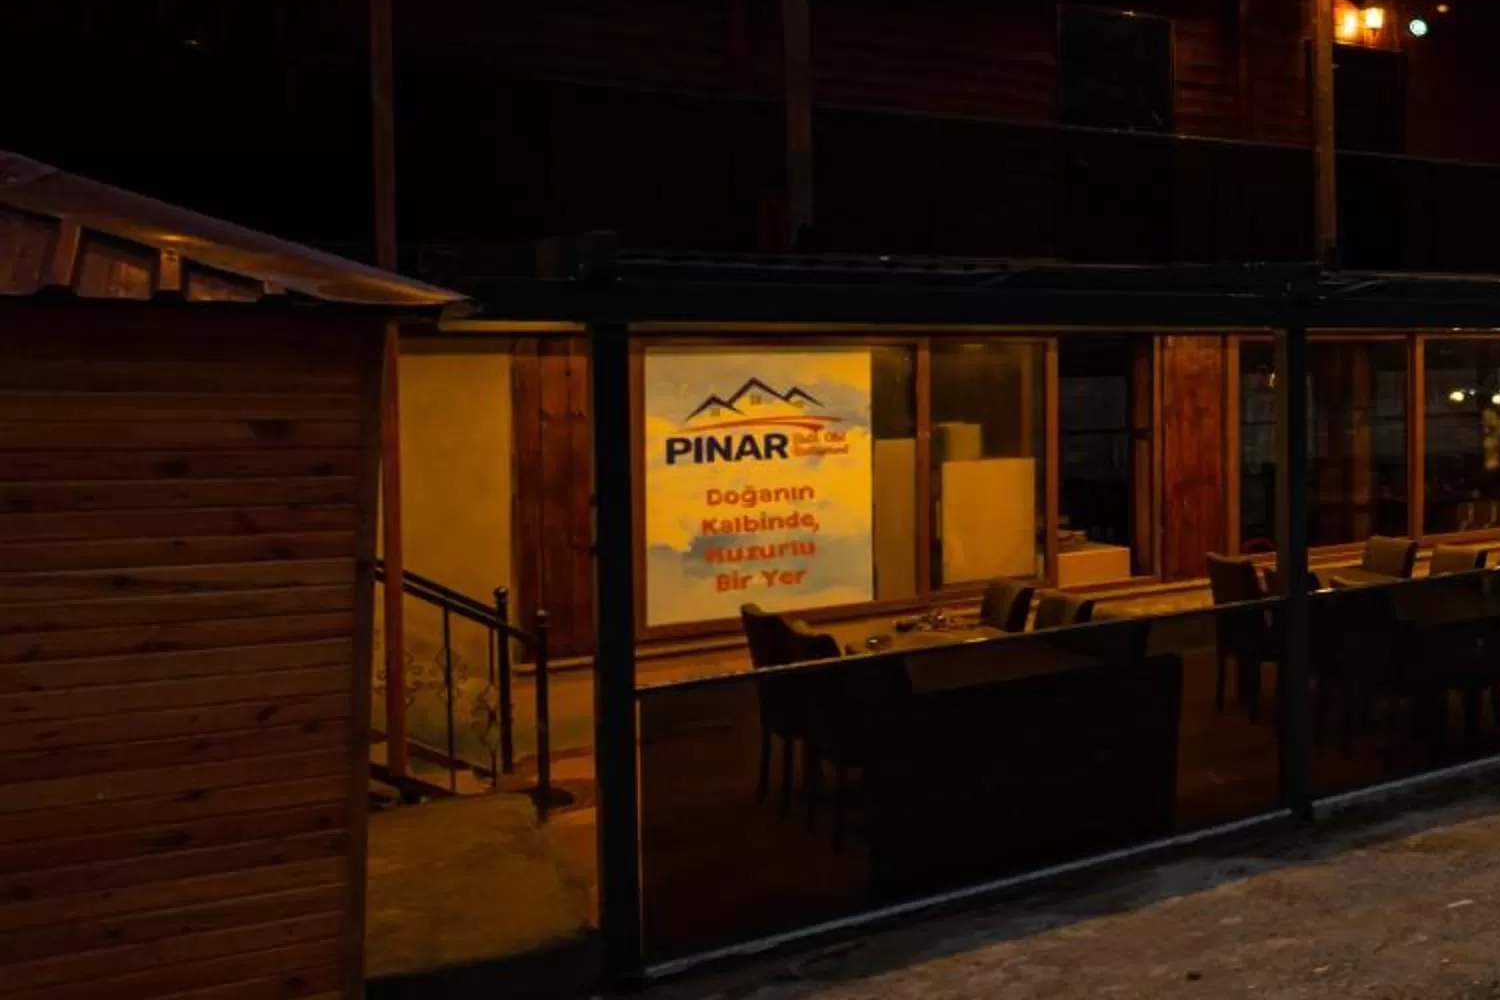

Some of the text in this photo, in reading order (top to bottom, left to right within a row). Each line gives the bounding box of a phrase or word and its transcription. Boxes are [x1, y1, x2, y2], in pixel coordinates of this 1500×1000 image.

[665, 432, 788, 465] PINAR
[706, 485, 815, 508] Doğanın
[702, 511, 820, 535] Kalbinde,
[715, 568, 808, 592] Bir Yer
